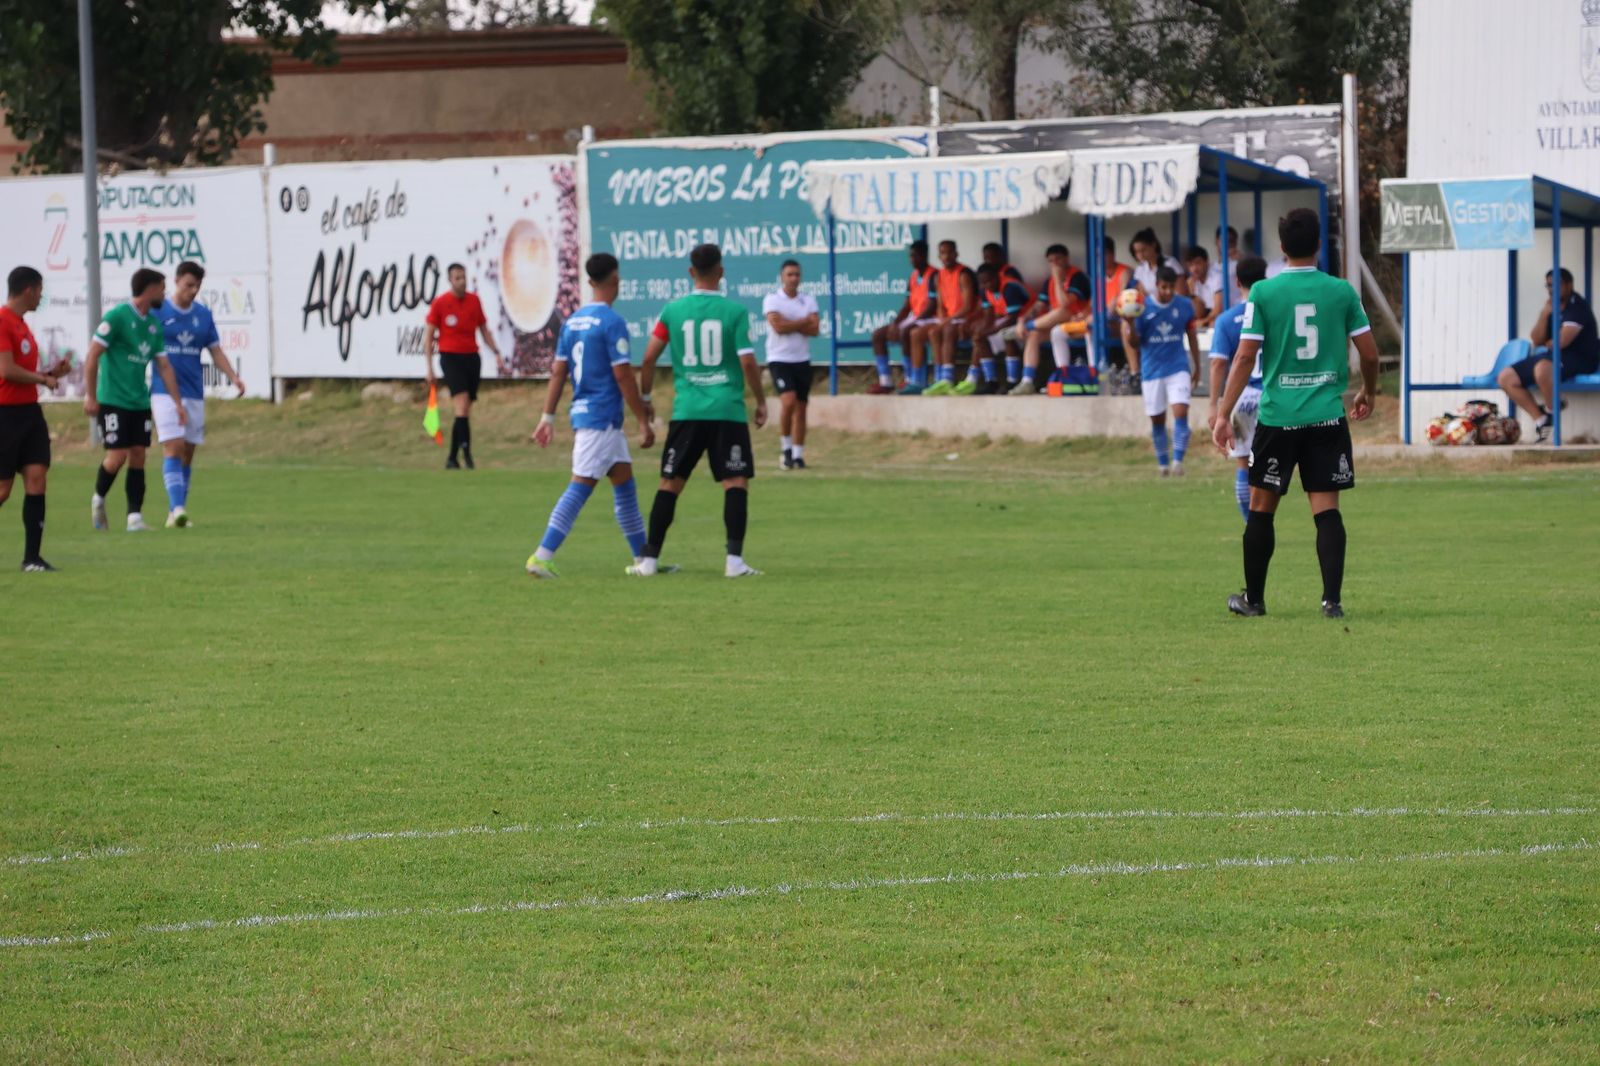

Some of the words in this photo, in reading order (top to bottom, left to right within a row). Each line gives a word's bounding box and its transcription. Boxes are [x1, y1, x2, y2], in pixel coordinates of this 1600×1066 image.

[608, 163, 728, 207] VIVEROS
[731, 161, 773, 202] LA
[779, 159, 813, 201] PE
[841, 166, 1022, 215] TALLERES
[321, 194, 339, 235] el
[342, 186, 380, 242] café
[384, 179, 408, 219] de
[1384, 201, 1444, 226] METAL
[1453, 199, 1531, 225] GESTION
[102, 229, 206, 267] AMORA
[611, 229, 667, 260] VENTA
[673, 228, 698, 259] DE
[785, 224, 801, 250] Y
[302, 243, 441, 363] Alfonso
[681, 319, 723, 366] 10
[1294, 303, 1319, 360] 5
